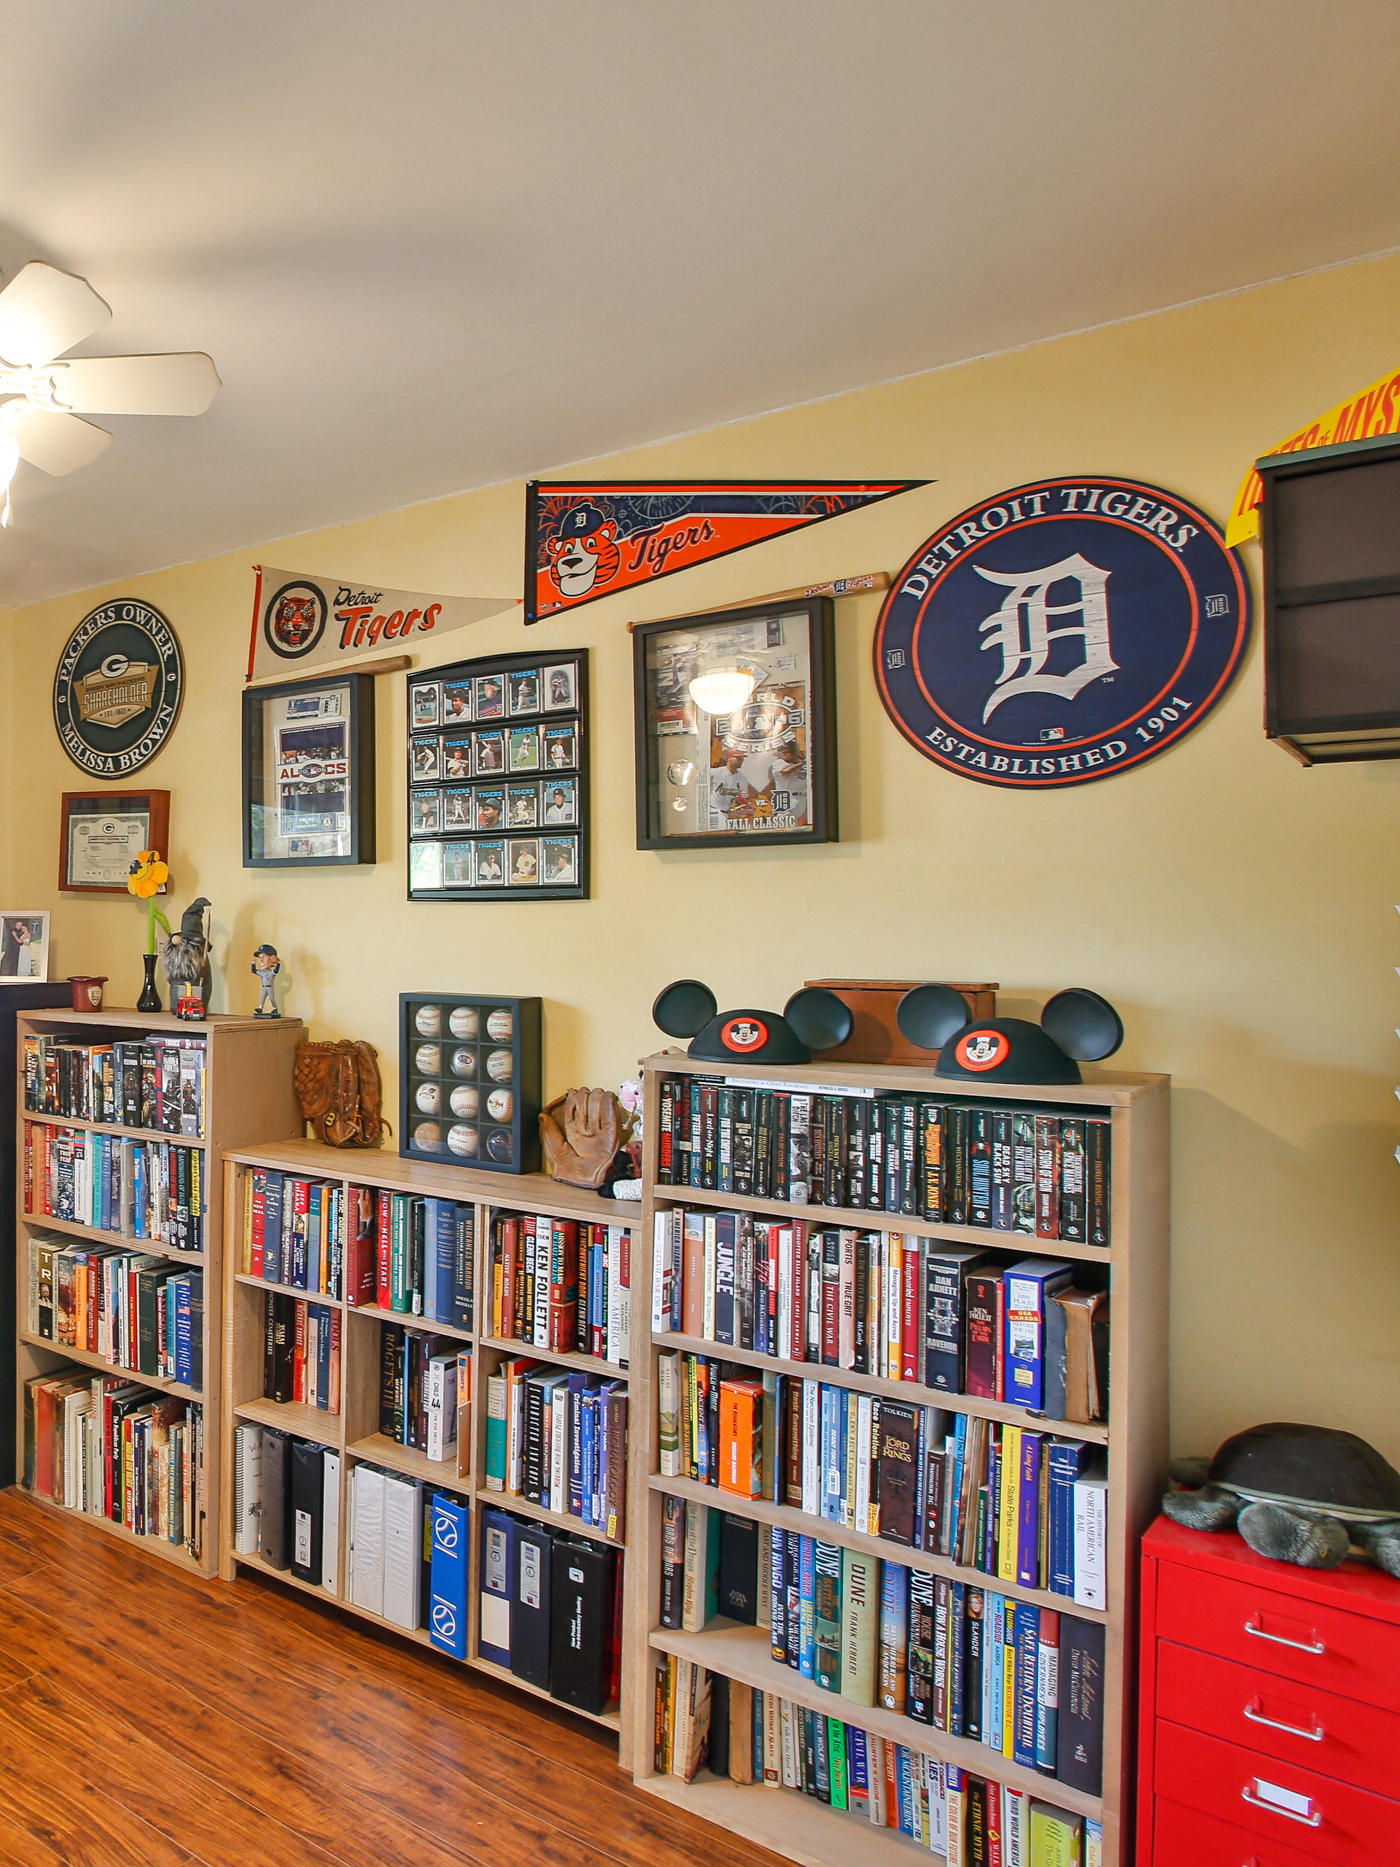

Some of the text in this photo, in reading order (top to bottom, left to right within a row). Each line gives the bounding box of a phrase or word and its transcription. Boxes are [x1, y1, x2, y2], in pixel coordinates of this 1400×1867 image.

[627, 518, 715, 574] Tigers
[901, 488, 1199, 600] DETROIT TIGERS
[334, 586, 383, 606] Detroit
[335, 602, 442, 649] Tigers
[971, 552, 1122, 725] D
[61, 605, 175, 682] PACKERS OWNER
[100, 654, 129, 678] G
[512, 670, 536, 678] TIGERS
[84, 683, 148, 713] SHAREHOLDER
[61, 704, 173, 772] MELISSA BROWN
[547, 728, 573, 736] TIGERS
[723, 733, 796, 751] SERIES
[925, 696, 1193, 776] ESTABLISHED 1901
[726, 816, 796, 830] FALL CLASSIC
[800, 1103, 808, 1127] THE LAST
[661, 1097, 671, 1167] YOSEMITE MURDERS
[721, 1117, 730, 1164] FOR THE EMPEROR
[994, 1142, 1002, 1184] BLACK SUN
[1002, 1146, 1010, 1184] DEAD SKY
[1038, 1149, 1052, 1169] STORM
[1063, 1151, 1074, 1194] SPACE MARINES
[972, 1160, 989, 1205] SOUL HUNTER
[1039, 1178, 1052, 1192] IRON
[717, 1242, 734, 1296] JUNGLE
[755, 1260, 769, 1283] 1776
[935, 1275, 952, 1286] DAN
[536, 1245, 548, 1329] KEN FOLLETT
[844, 1281, 852, 1300] TRUE
[826, 1304, 834, 1324] CIVIL
[844, 1300, 852, 1317] GRIT
[892, 1299, 898, 1307] Up
[969, 1311, 992, 1322] FOLLETT
[1009, 1315, 1040, 1323] CANADA
[331, 1317, 339, 1352] TOOLS
[927, 1338, 958, 1351] RAVENOR
[431, 1398, 440, 1410] 44
[883, 1405, 913, 1420] TOLKIEN
[882, 1448, 912, 1463] RINGS
[884, 1434, 910, 1451] LORD
[609, 1423, 620, 1507] ARCHAEOLOGY
[1006, 1485, 1015, 1527] State Parks
[664, 1523, 674, 1577] LORDS OF MARS
[815, 1541, 839, 1578] DUNE
[883, 1571, 897, 1614] DUNE
[911, 1569, 933, 1606] DUNE
[849, 1564, 866, 1675] DUNE FRANK HERBERT
[922, 1615, 931, 1641] HOUSE
[935, 1605, 946, 1624] HOW
[935, 1631, 946, 1658] HOUSE
[935, 1659, 945, 1688] WORKS
[1022, 1629, 1037, 1748] SAFE RETURN DOUBTFUL
[1047, 1655, 1056, 1697] MANAGING
[1037, 1652, 1047, 1751] GOVERNMENT EMPLOYEES
[854, 1730, 866, 1784] CIVIL WAR
[886, 1750, 894, 1783] PROPERTY
[929, 1760, 938, 1781] LIES
[903, 1764, 913, 1830] MOUNTAINEERING
[949, 1794, 958, 1805] THE
[949, 1807, 957, 1824] COLOR
[949, 1833, 957, 1843] OUR
[971, 1802, 982, 1861] ETHNIC MYTH
[1010, 1796, 1021, 1866] THIRD WORLD AMERICA
[949, 1844, 958, 1865] FUTURE
